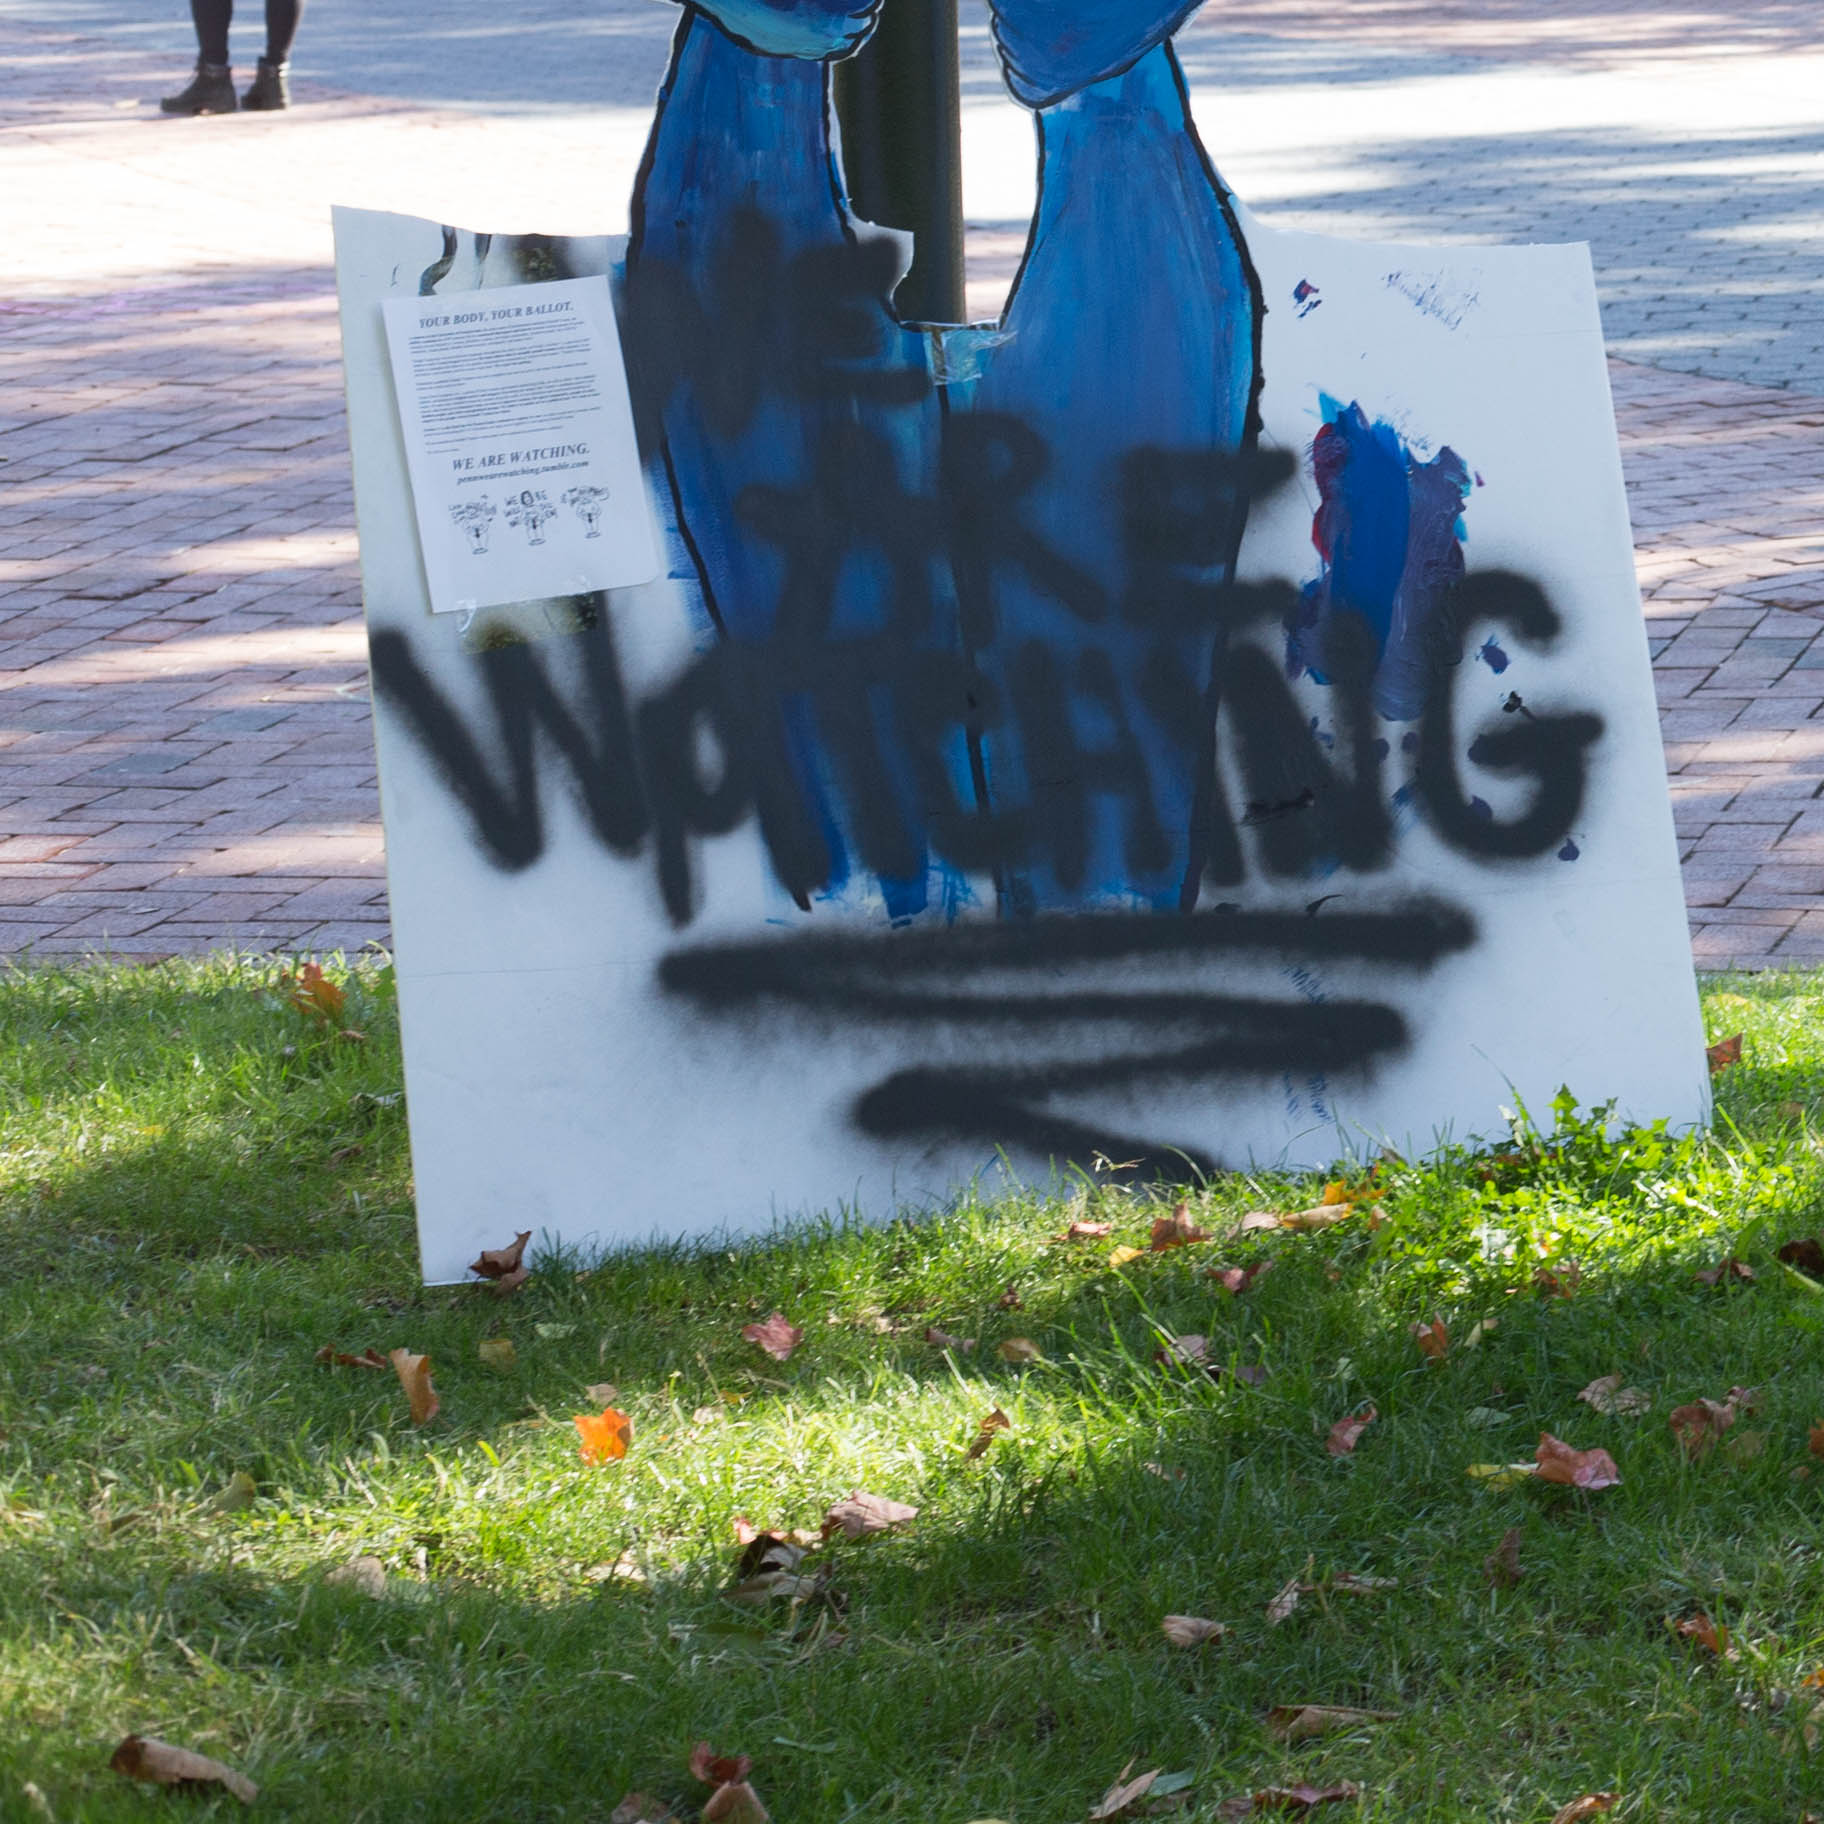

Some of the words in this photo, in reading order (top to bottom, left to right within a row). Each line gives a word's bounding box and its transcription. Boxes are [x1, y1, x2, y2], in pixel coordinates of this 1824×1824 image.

[419, 315, 451, 329] YOUR
[491, 307, 522, 321] YOUR
[452, 457, 474, 472] WE
[478, 453, 507, 468] ARE
[510, 442, 591, 464] WATCHING.
